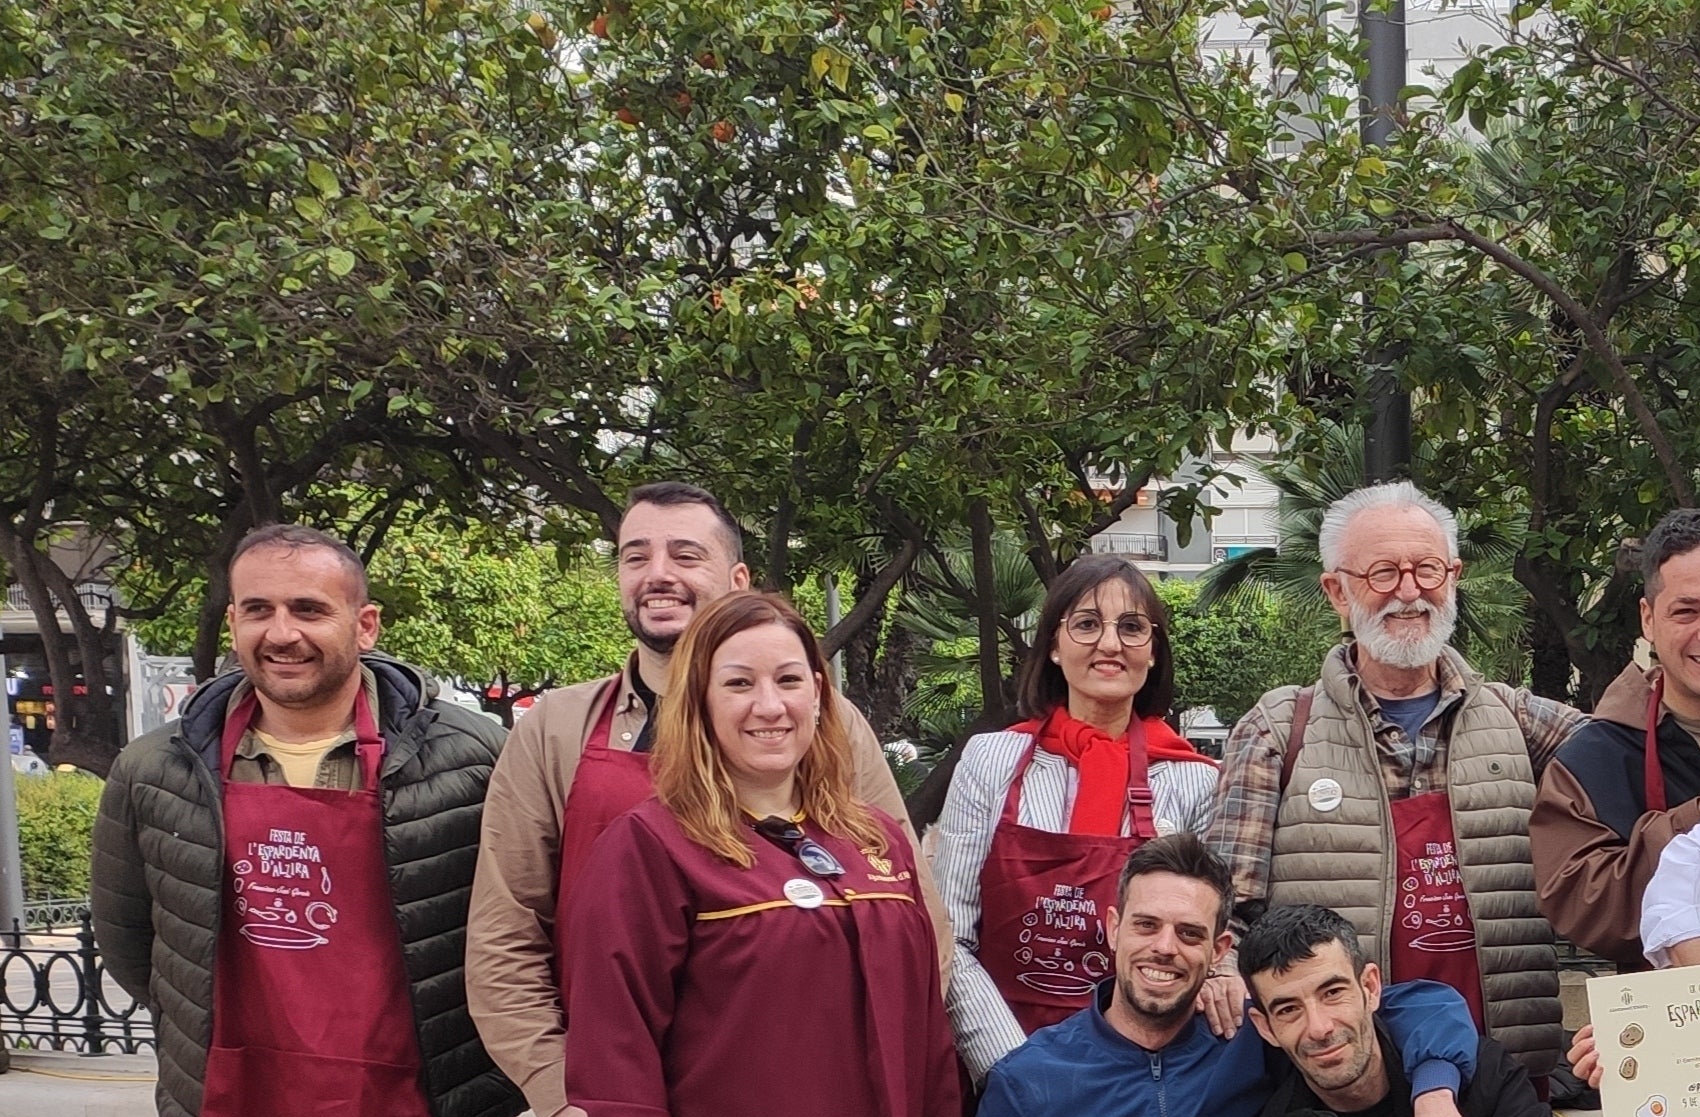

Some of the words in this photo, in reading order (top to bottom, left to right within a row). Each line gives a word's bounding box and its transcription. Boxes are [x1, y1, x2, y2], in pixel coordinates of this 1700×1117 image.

[294, 832, 308, 845] DE
[261, 860, 310, 879] D'ALZIRA
[1045, 913, 1087, 931] D'ALZIRA
[1690, 1097, 1697, 1106] DE
